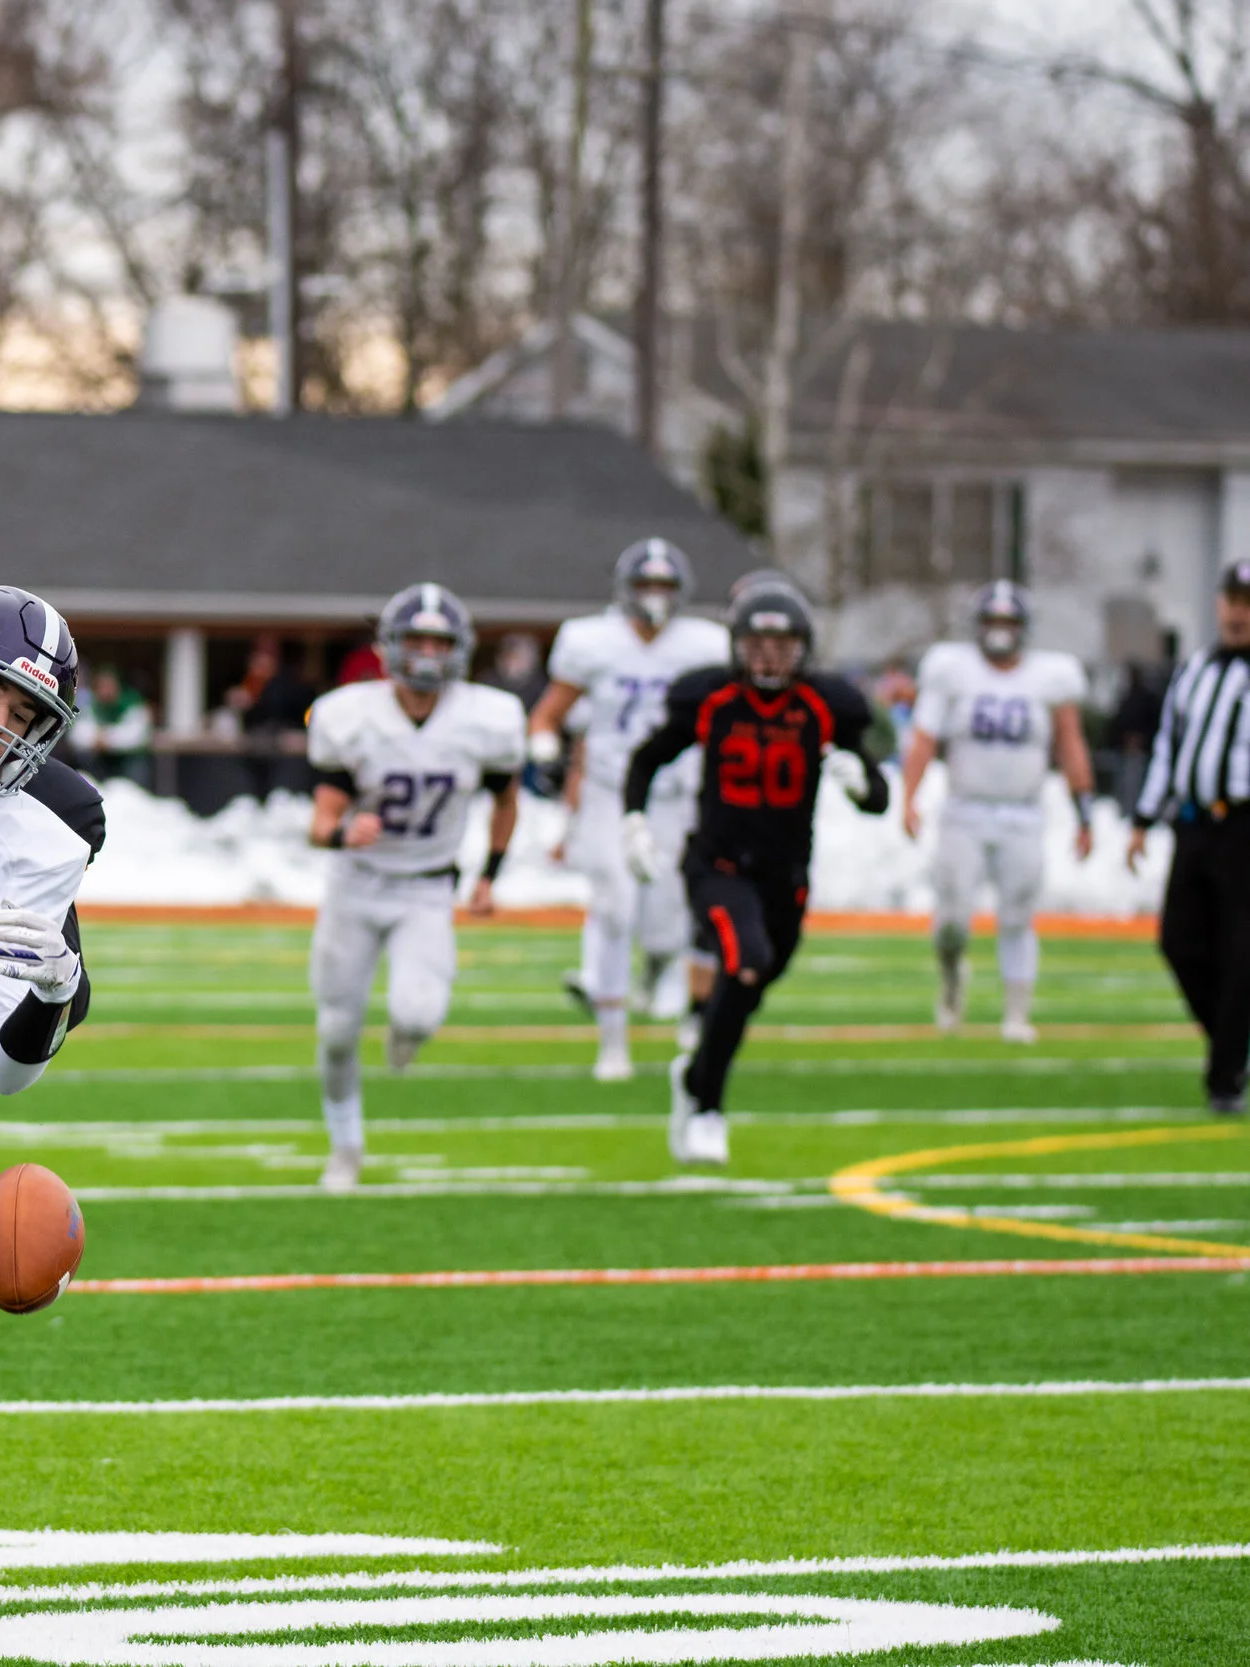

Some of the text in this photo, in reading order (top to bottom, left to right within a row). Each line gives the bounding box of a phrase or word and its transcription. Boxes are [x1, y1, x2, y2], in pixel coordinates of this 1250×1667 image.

[20, 659, 57, 690] Riddell
[720, 735, 806, 808] 20
[380, 773, 456, 836] 27
